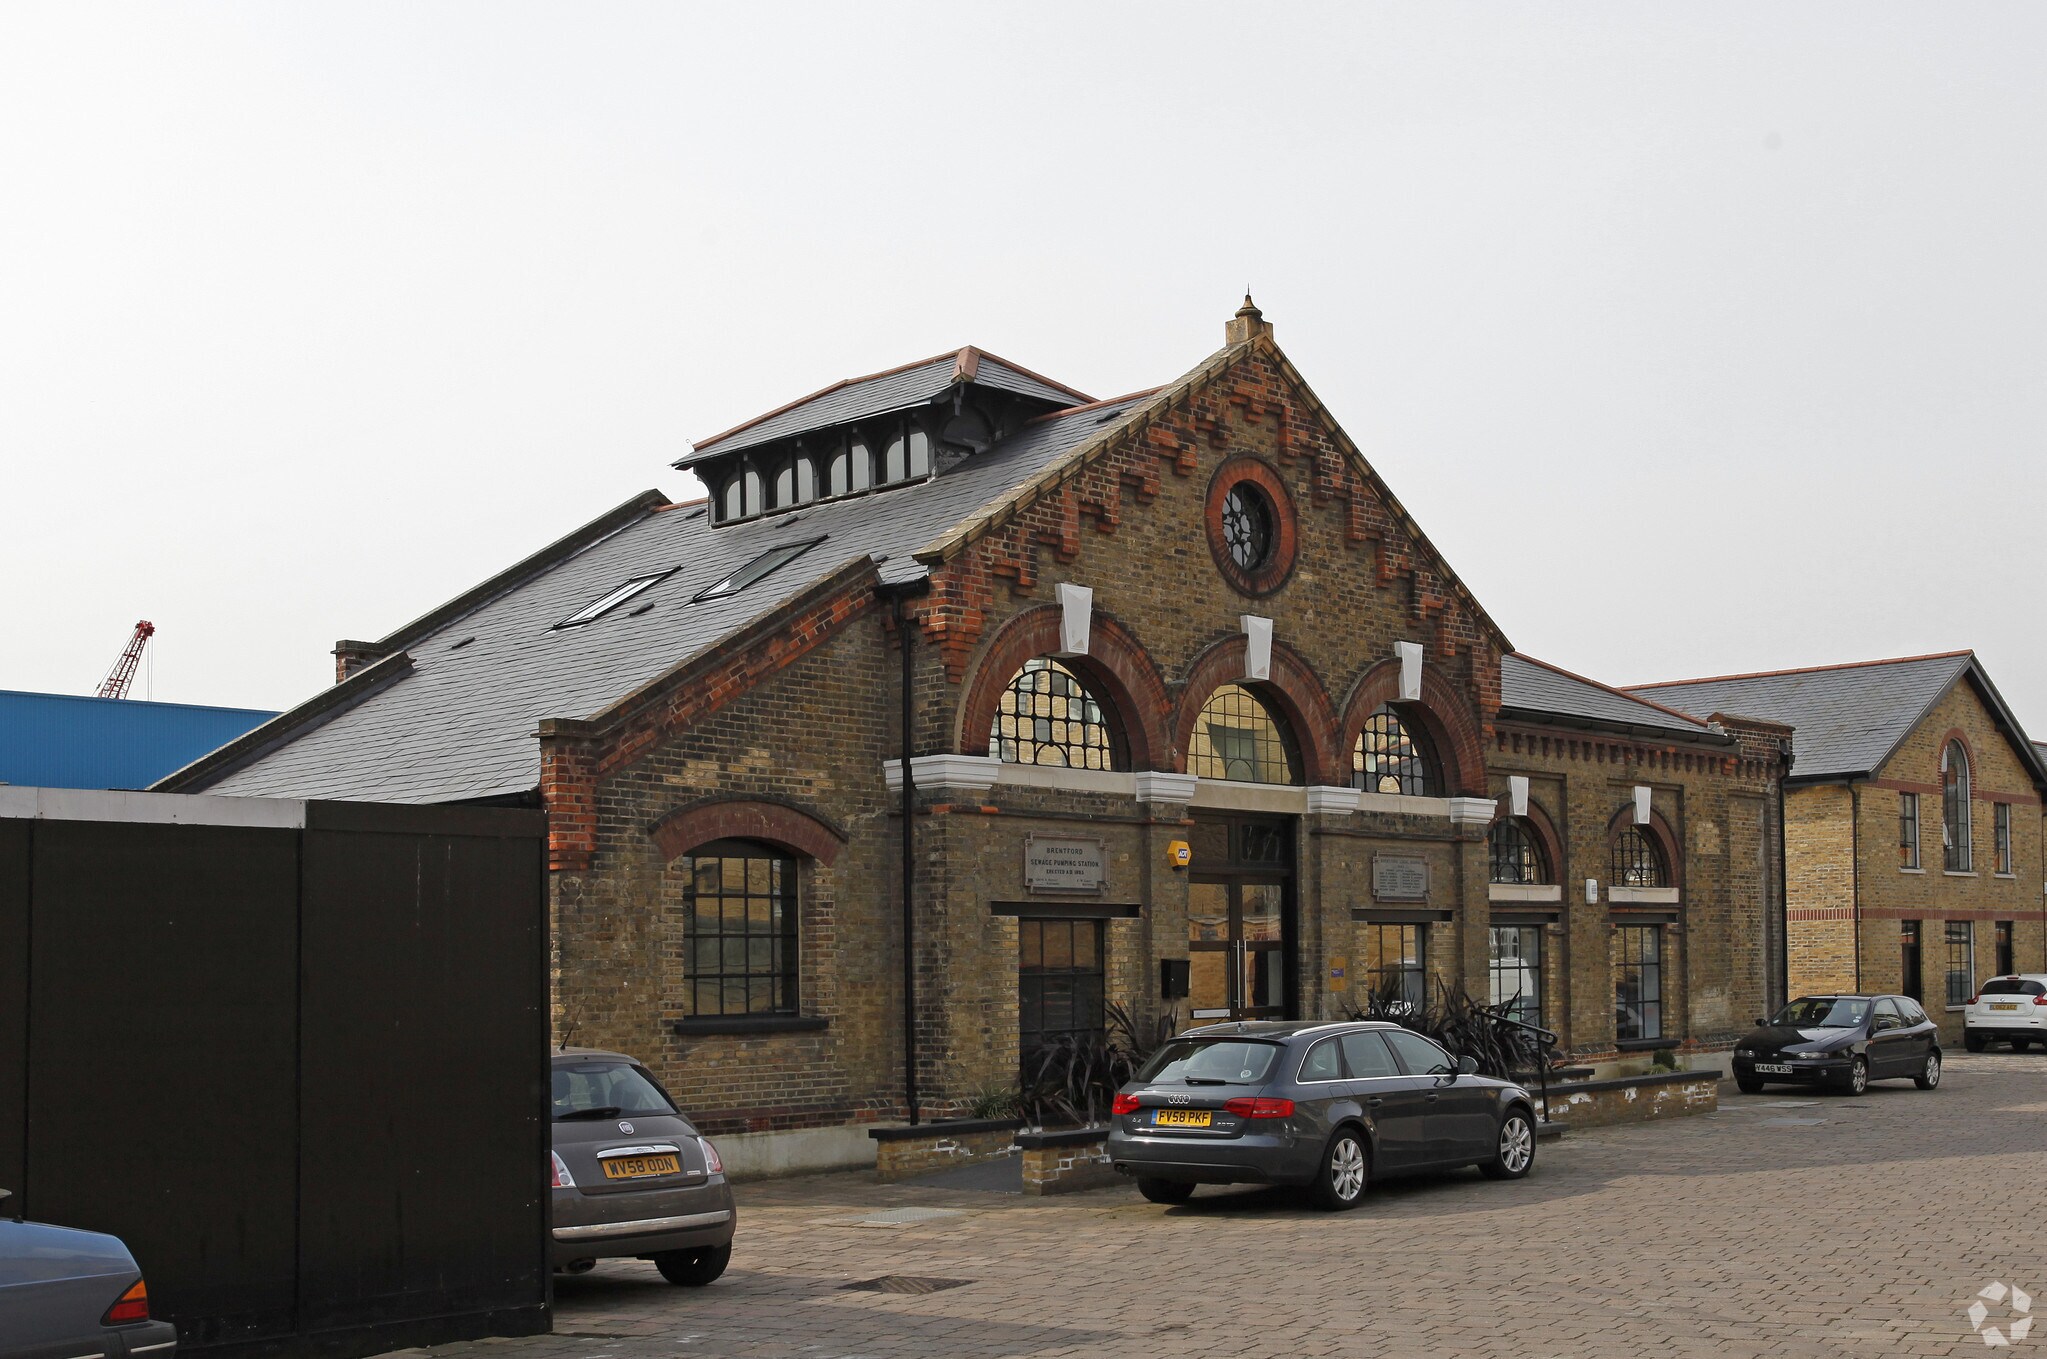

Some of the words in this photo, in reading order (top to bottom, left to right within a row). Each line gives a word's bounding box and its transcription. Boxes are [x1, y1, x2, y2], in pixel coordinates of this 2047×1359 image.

[1046, 847, 1083, 855] BRENTFORD
[1756, 1064, 1776, 1072] Y446
[1776, 1065, 1792, 1073] WSS
[1158, 1111, 1186, 1123] FV58
[1187, 1111, 1210, 1123] PKF
[608, 1159, 646, 1176] WV58
[648, 1157, 675, 1172] ODN
